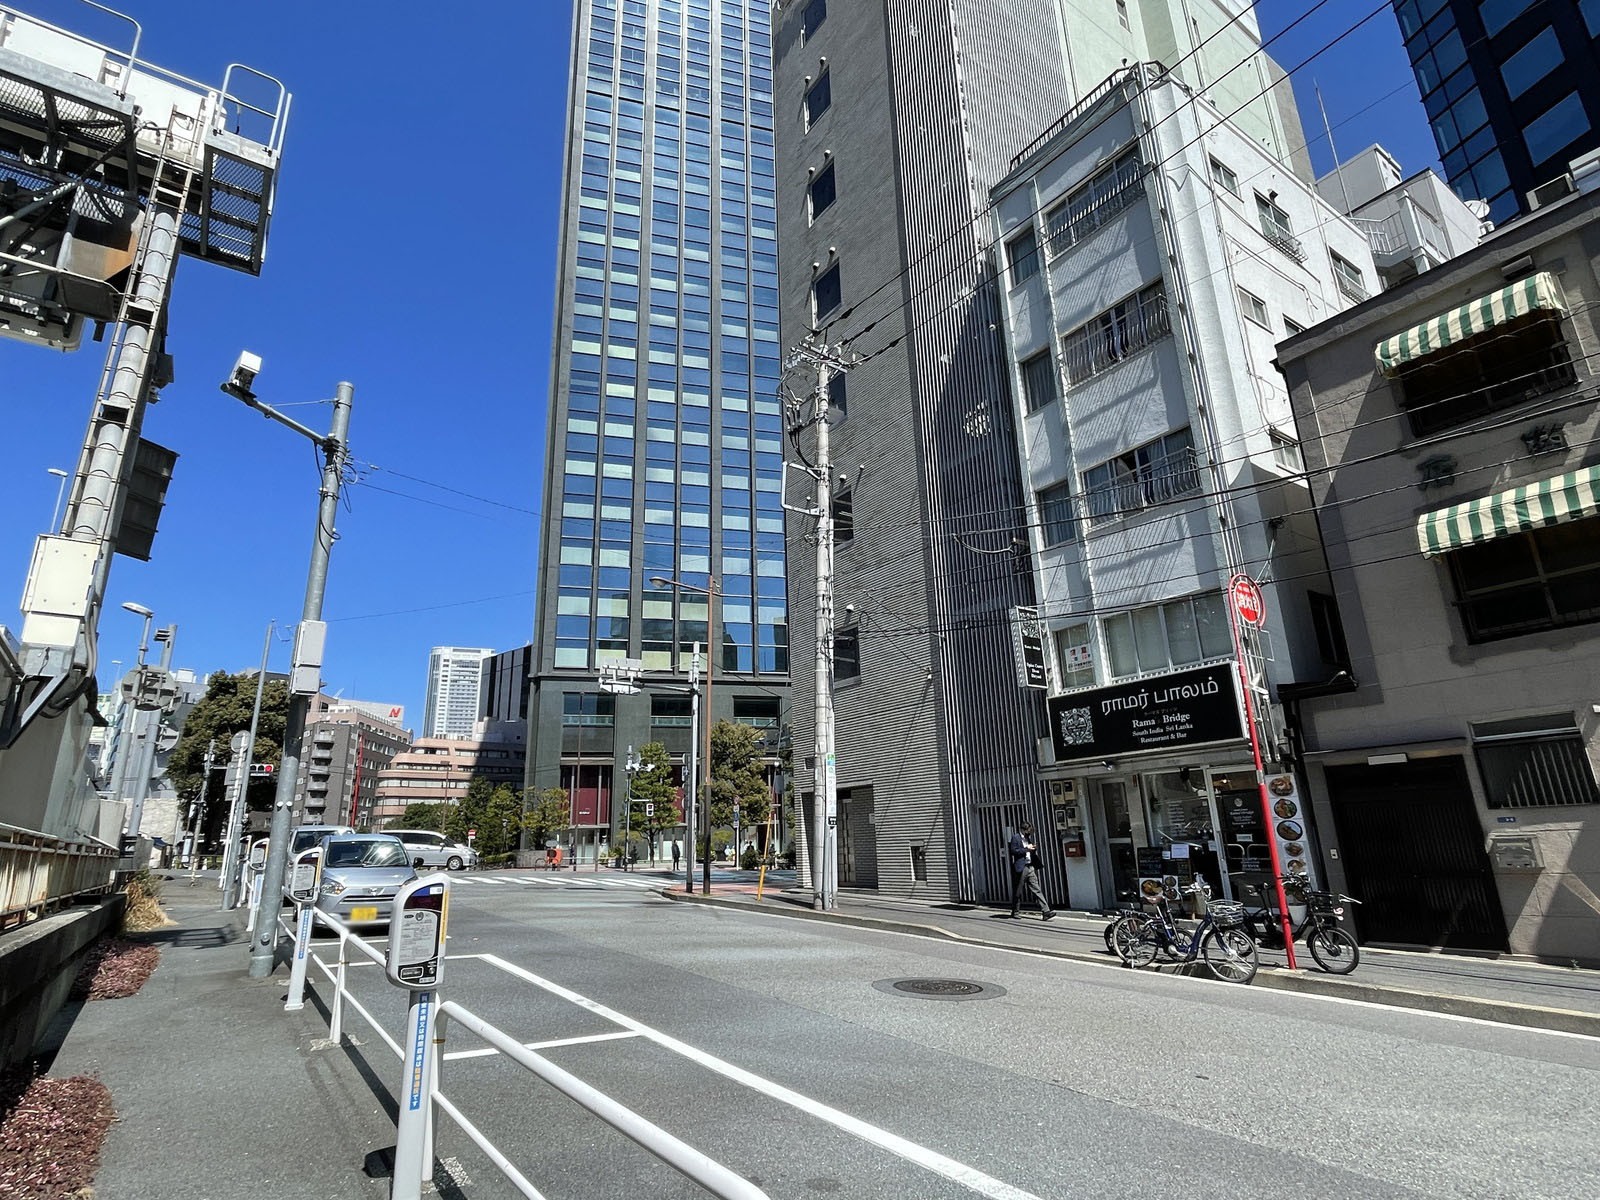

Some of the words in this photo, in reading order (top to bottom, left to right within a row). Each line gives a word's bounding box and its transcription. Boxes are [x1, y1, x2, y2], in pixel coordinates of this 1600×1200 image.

[1101, 688, 1149, 716] ராமர்
[1154, 676, 1219, 703] பாலம்
[1132, 718, 1156, 728] Rama
[1162, 713, 1191, 724] Bridge
[1149, 727, 1164, 735] India
[1165, 725, 1175, 733] Sri
[1175, 723, 1194, 731] Lanka
[1140, 735, 1170, 744] Restaurant
